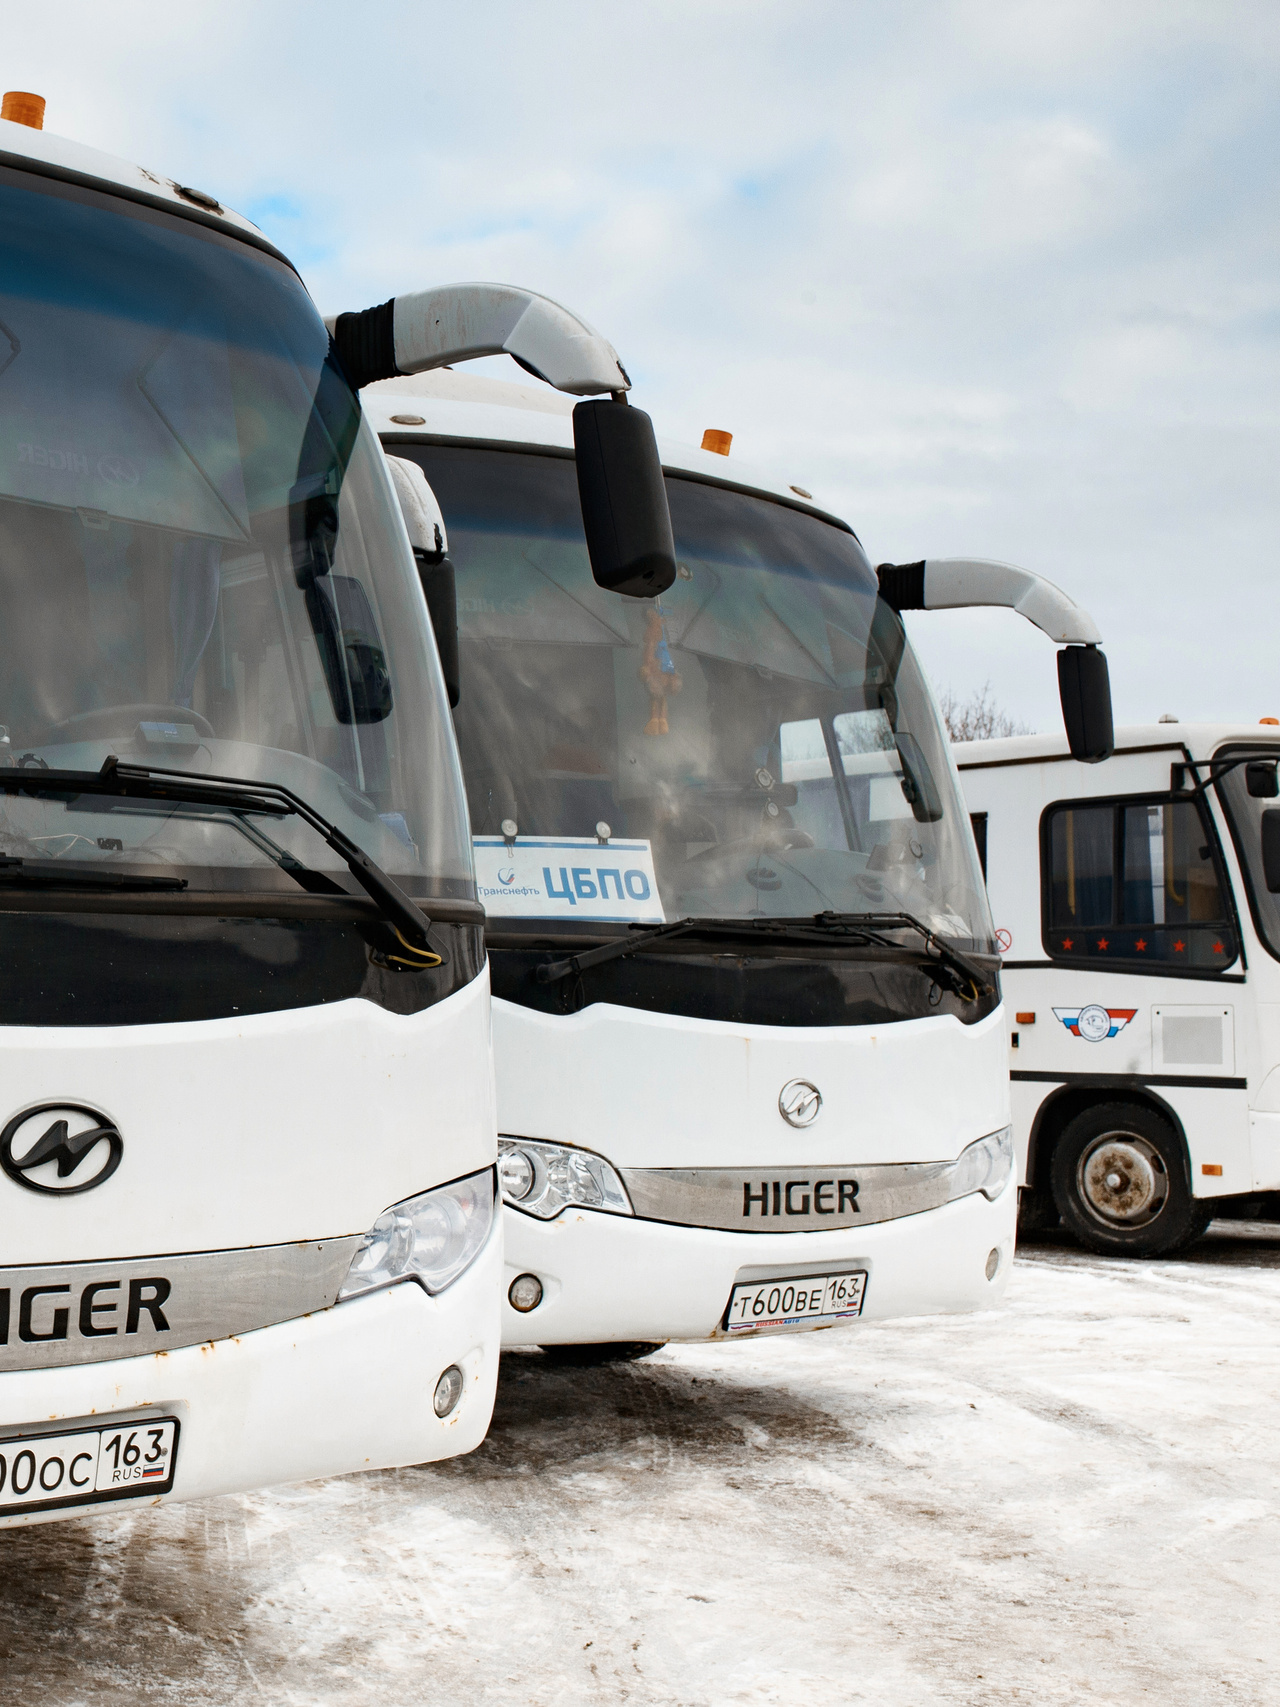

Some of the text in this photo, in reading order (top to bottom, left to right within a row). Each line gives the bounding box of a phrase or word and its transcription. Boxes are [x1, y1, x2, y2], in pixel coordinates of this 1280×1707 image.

[477, 886, 540, 898] Транснефть
[542, 867, 651, 905] ЦБПО
[743, 1179, 861, 1217] HIGER
[828, 1278, 859, 1300] 163
[831, 1299, 847, 1309] RUS
[105, 1428, 164, 1469] 163
[112, 1466, 141, 1483] RUS
